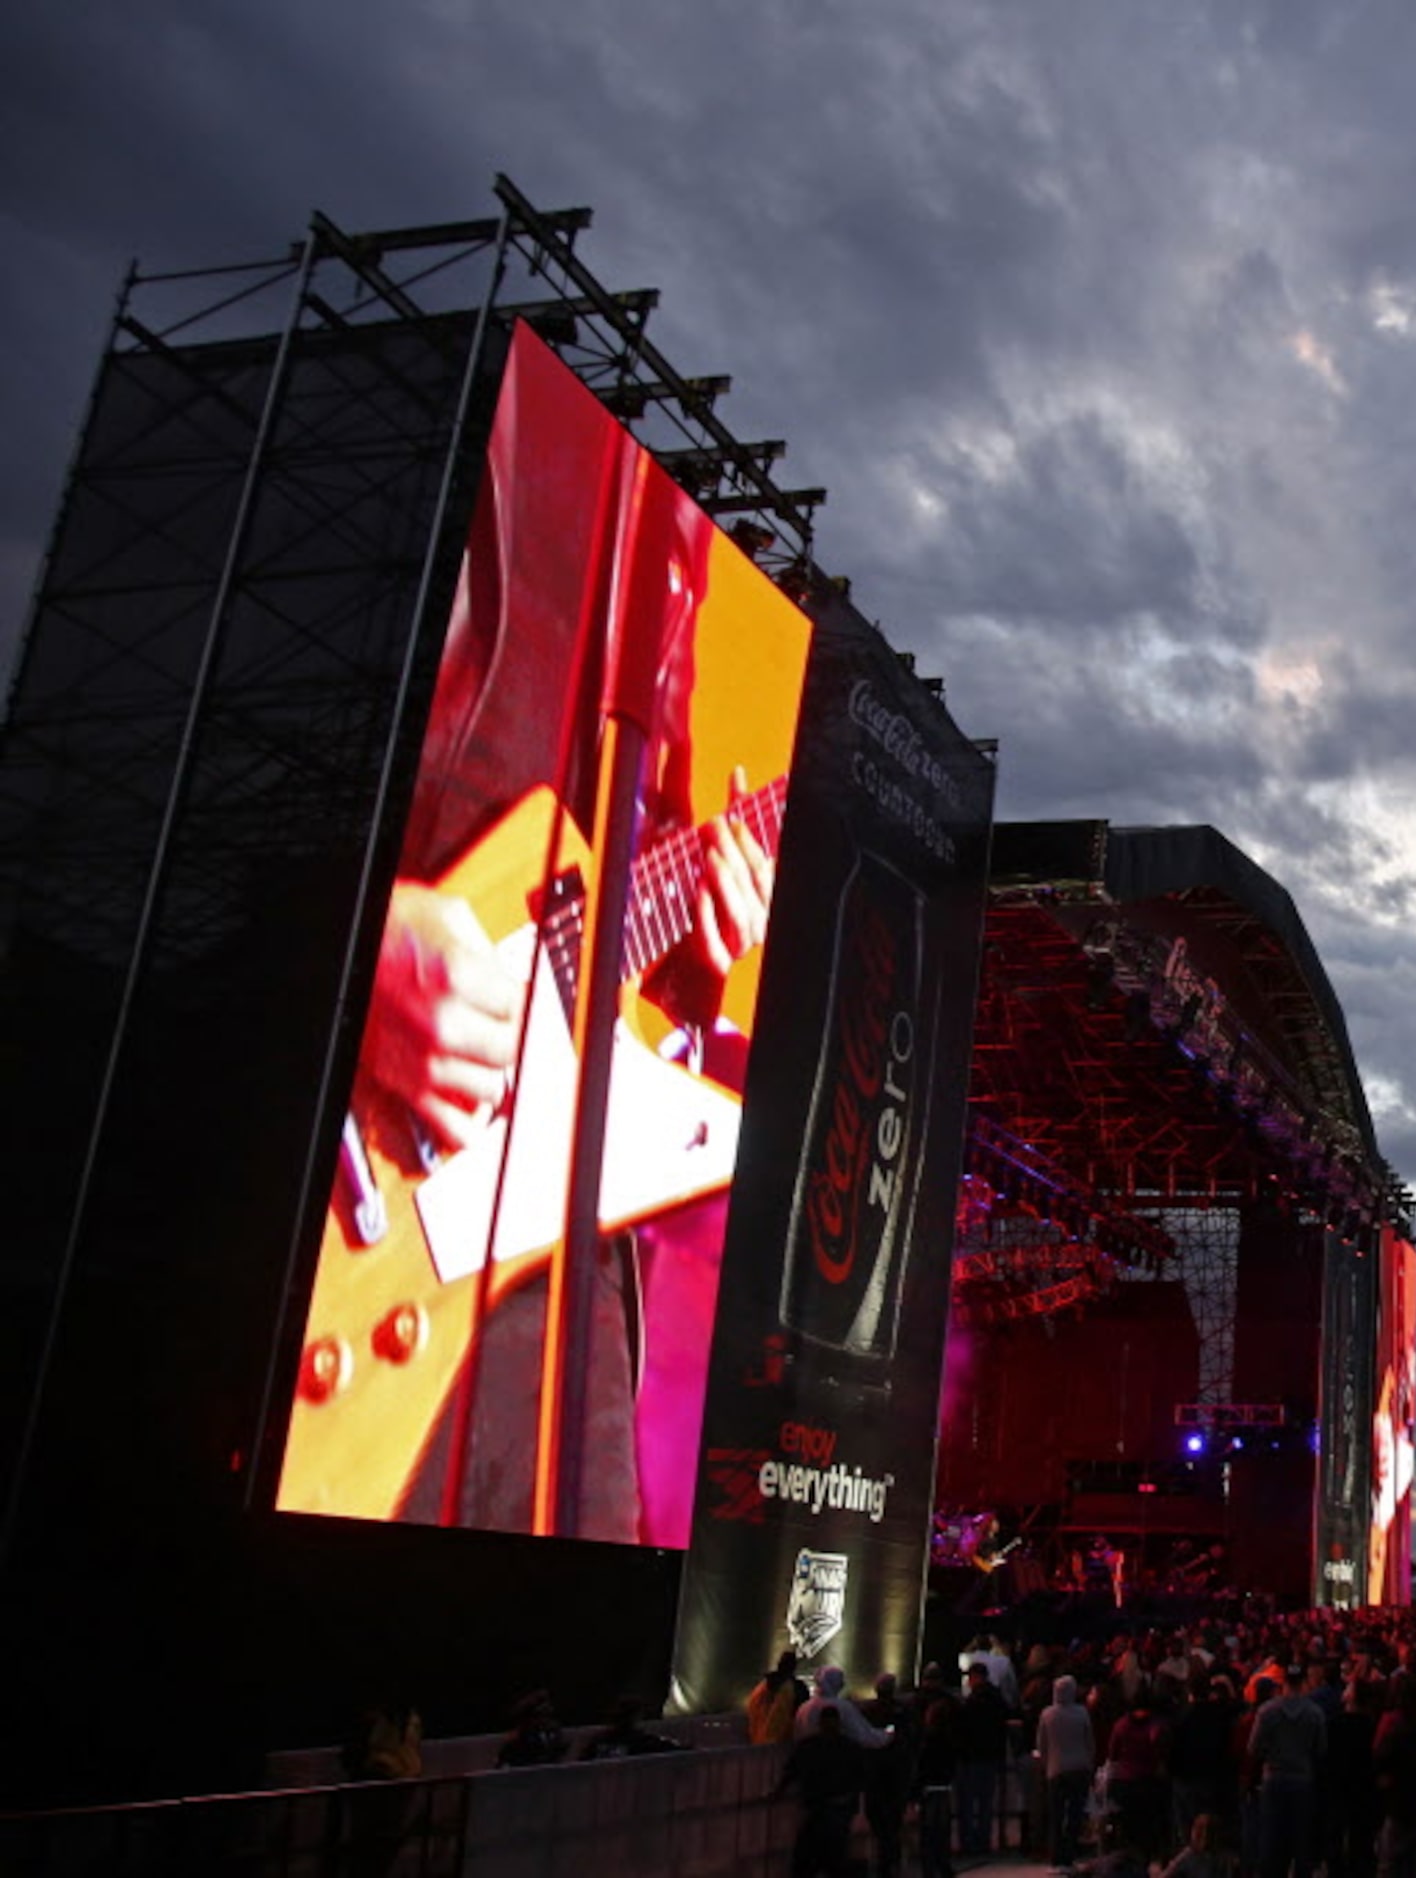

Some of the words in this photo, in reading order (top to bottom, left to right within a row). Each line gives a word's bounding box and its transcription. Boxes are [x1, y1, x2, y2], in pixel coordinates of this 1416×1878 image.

[866, 1010, 915, 1214] zero
[779, 1418, 838, 1469] enjoy
[757, 1460, 887, 1523] everything
